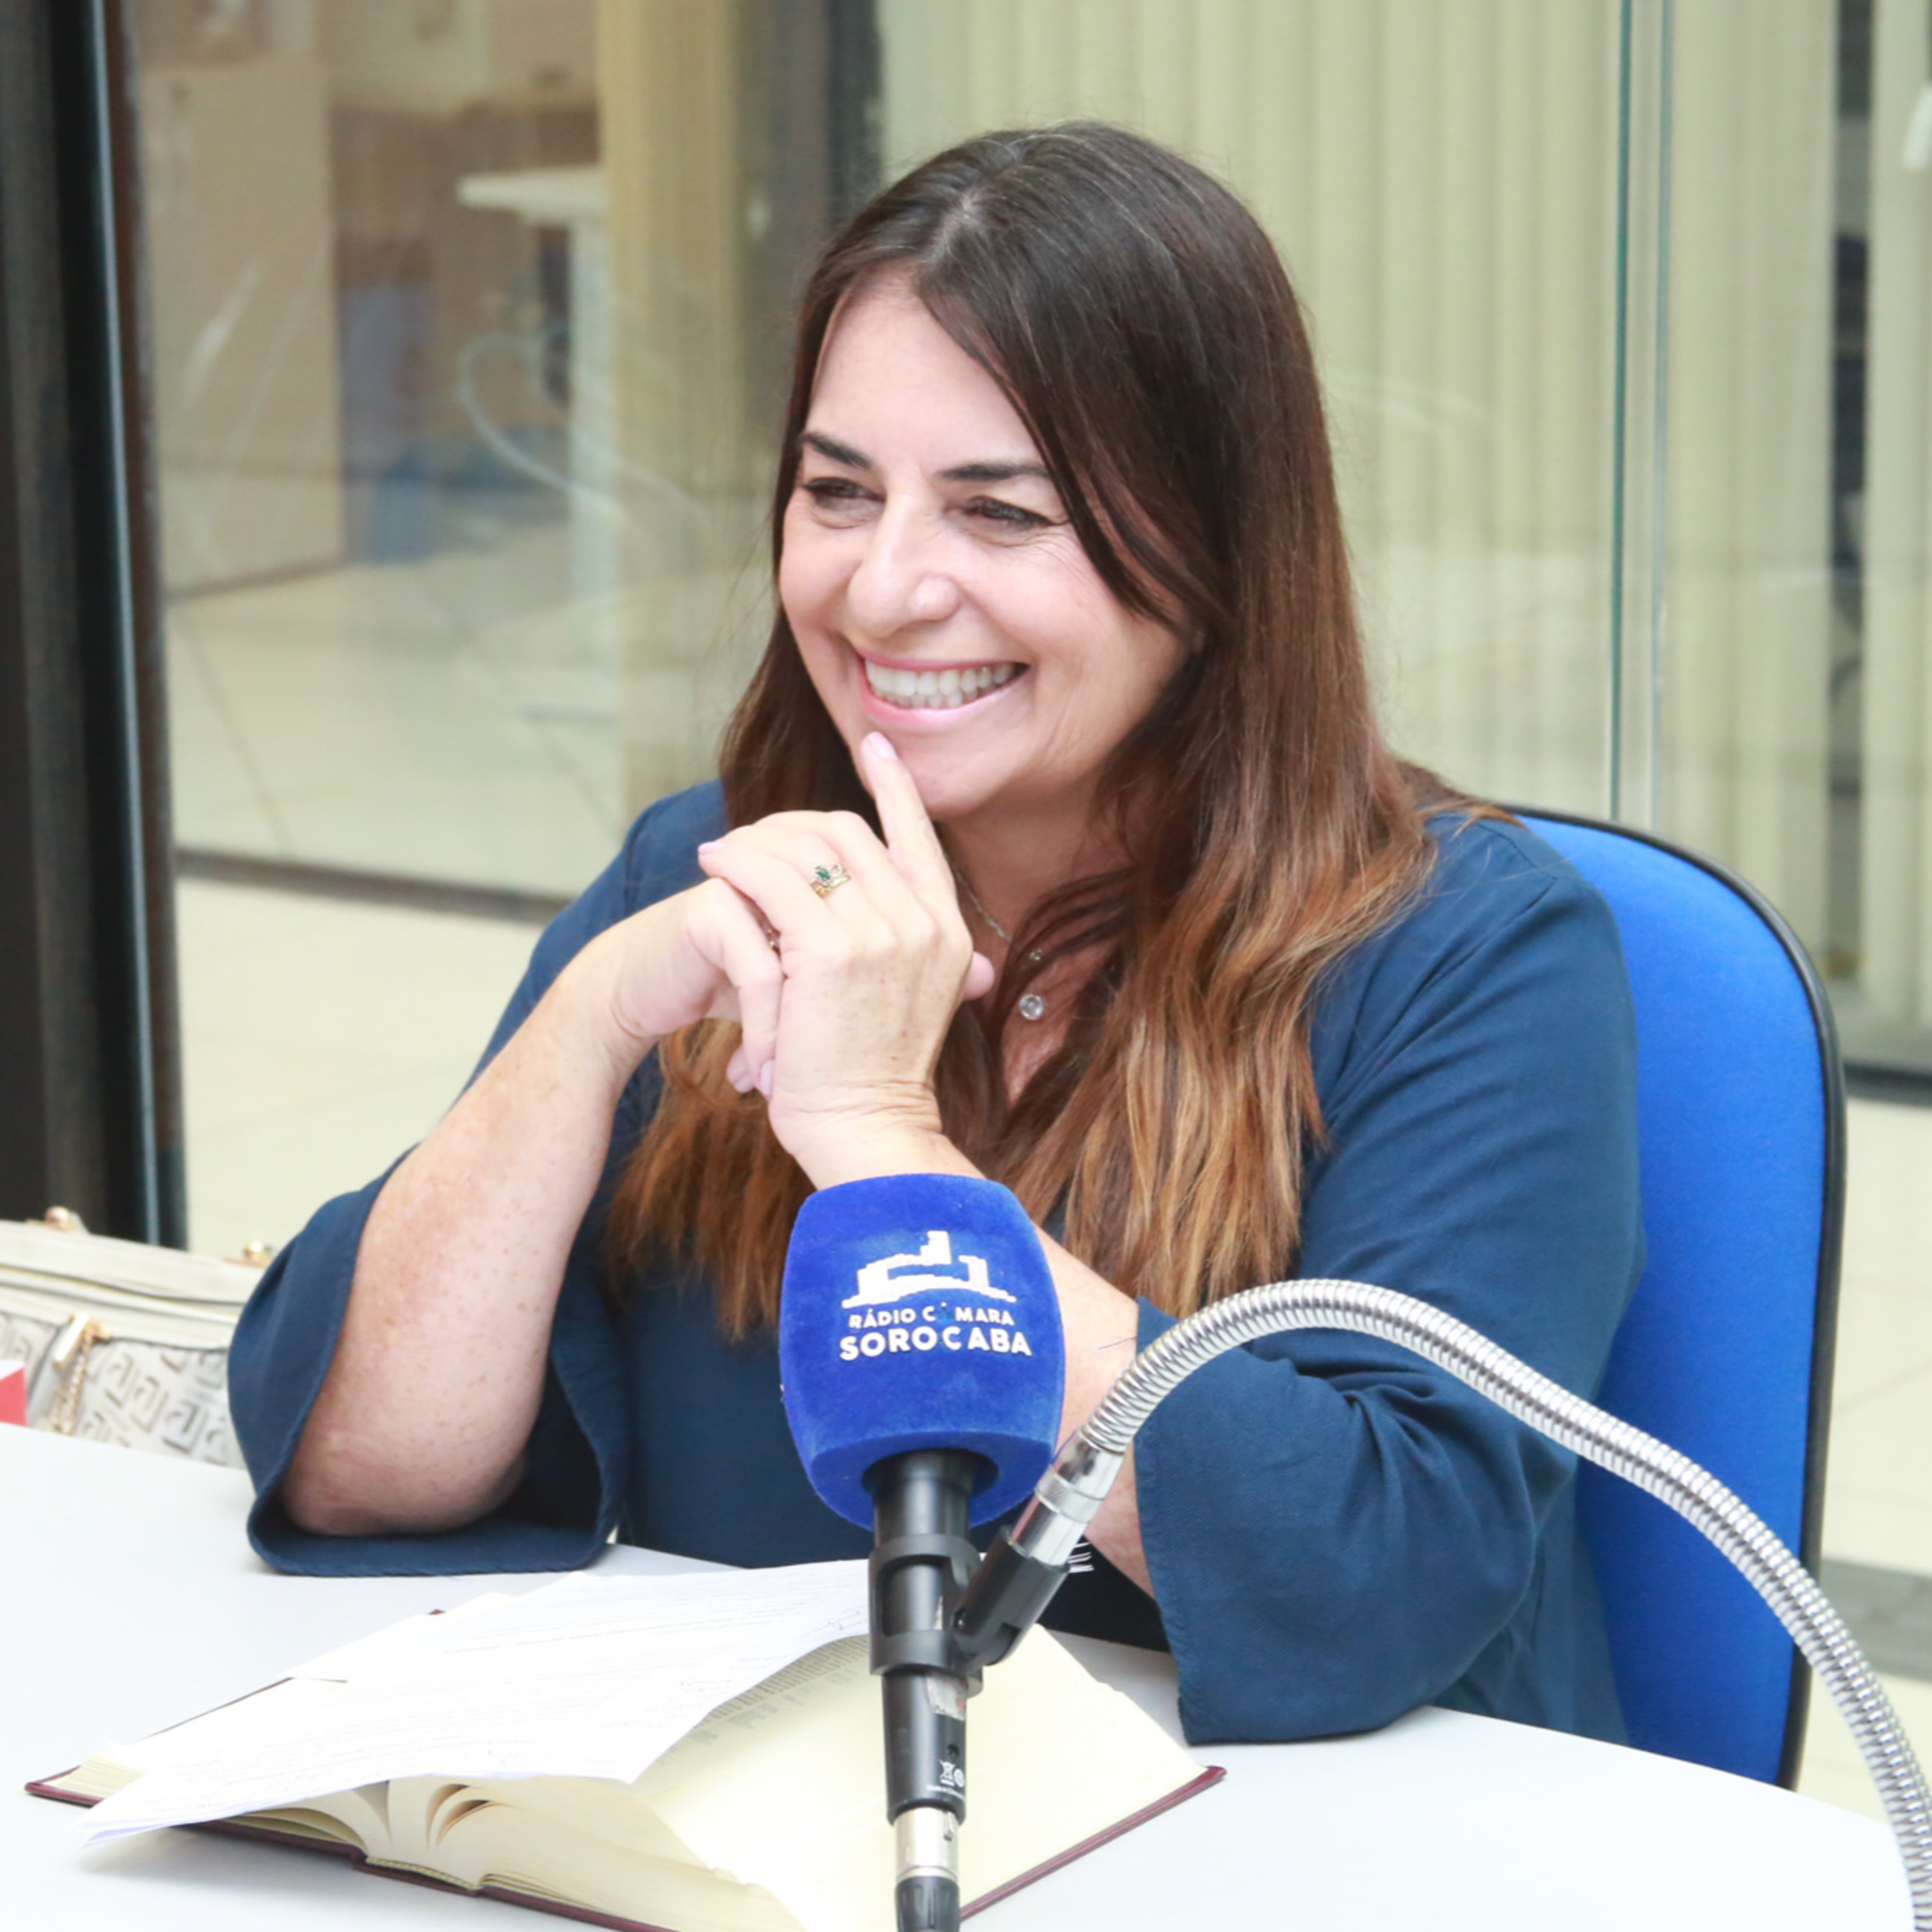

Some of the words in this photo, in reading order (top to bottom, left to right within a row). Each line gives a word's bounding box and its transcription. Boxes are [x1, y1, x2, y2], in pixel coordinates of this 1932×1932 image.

[848, 1308, 917, 1329] RÁDIO
[922, 1303, 1016, 1327] CMARA
[839, 1326, 1032, 1361] SOROCABA
